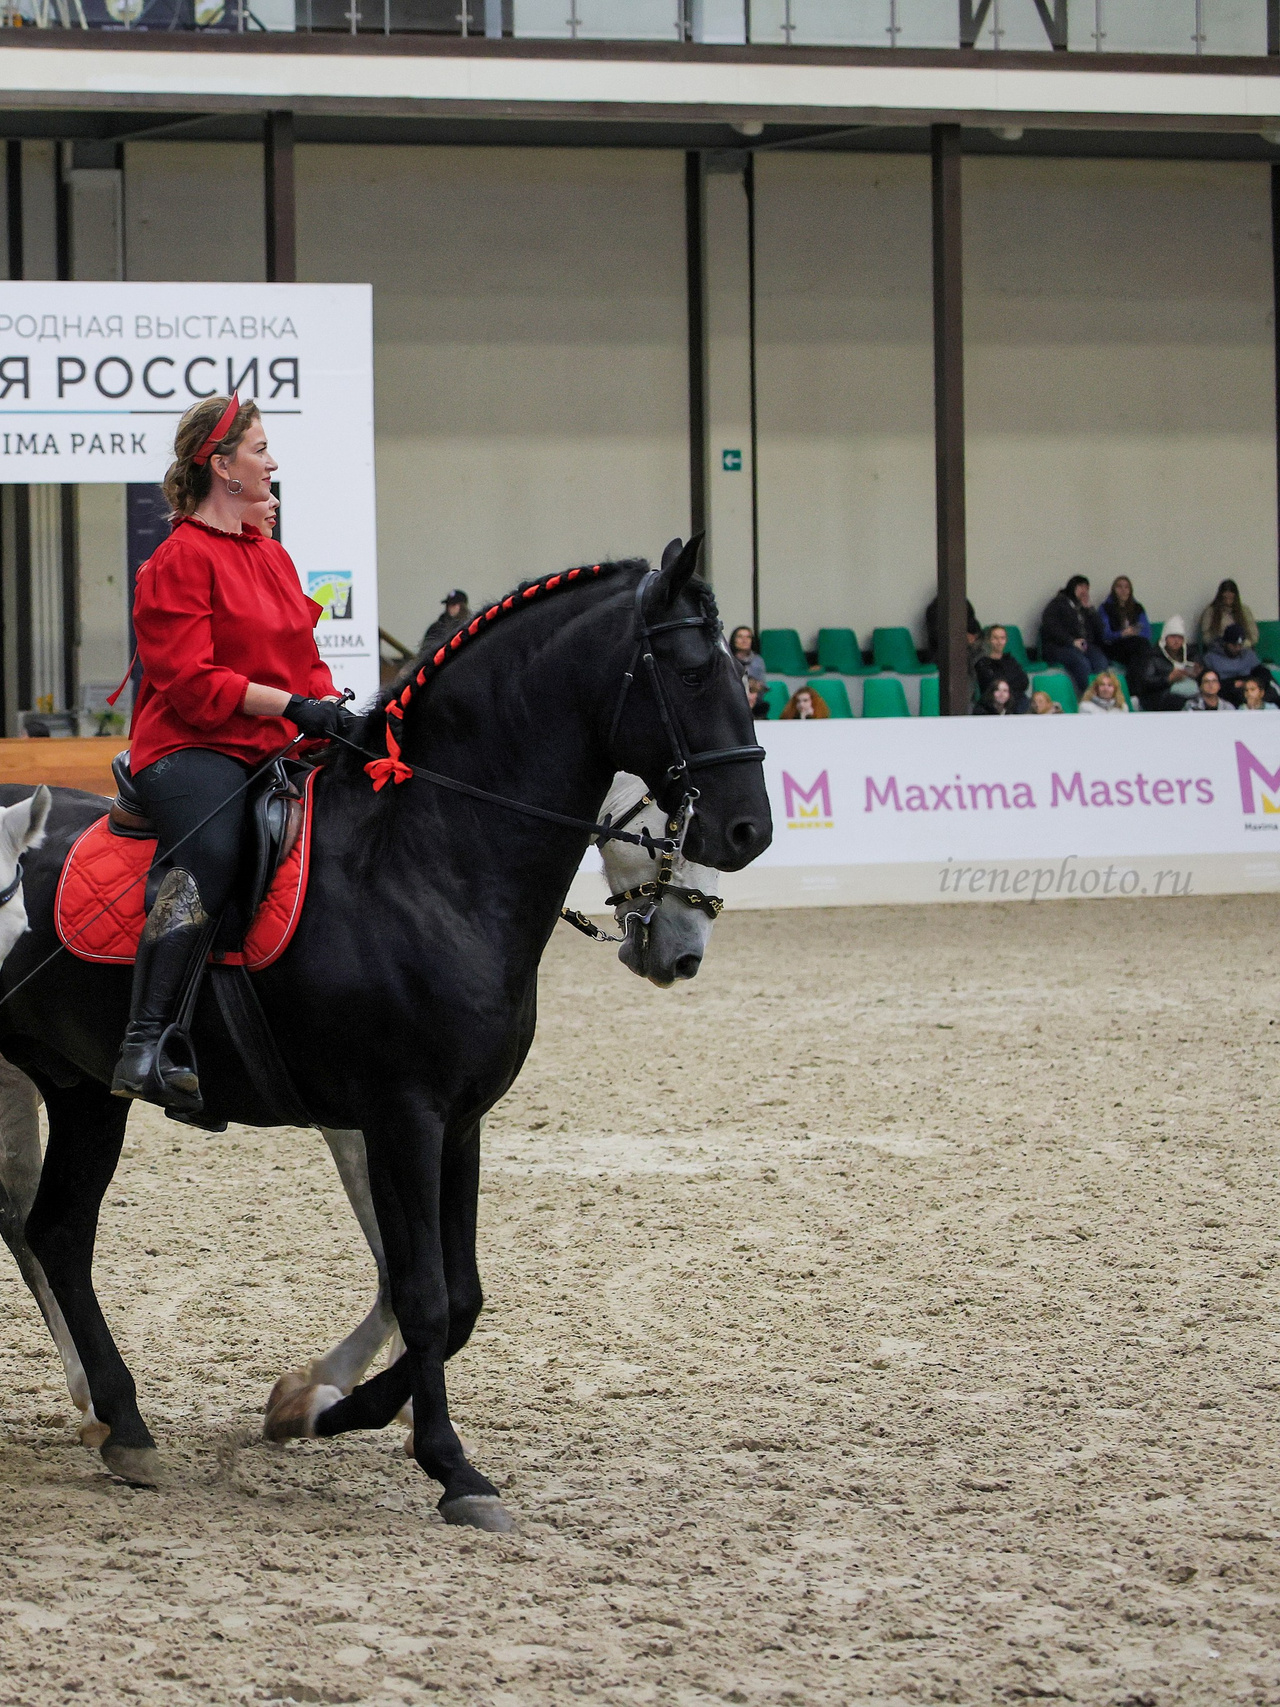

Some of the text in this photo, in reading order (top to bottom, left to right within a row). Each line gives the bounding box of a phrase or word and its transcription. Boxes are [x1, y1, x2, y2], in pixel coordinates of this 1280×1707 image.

[135, 315, 299, 339] ВЫСТАВКА
[57, 355, 299, 399] РОССИЯ
[71, 433, 147, 455] PARK
[316, 634, 365, 648] AXIMA
[864, 771, 1215, 813] Maxima Masters
